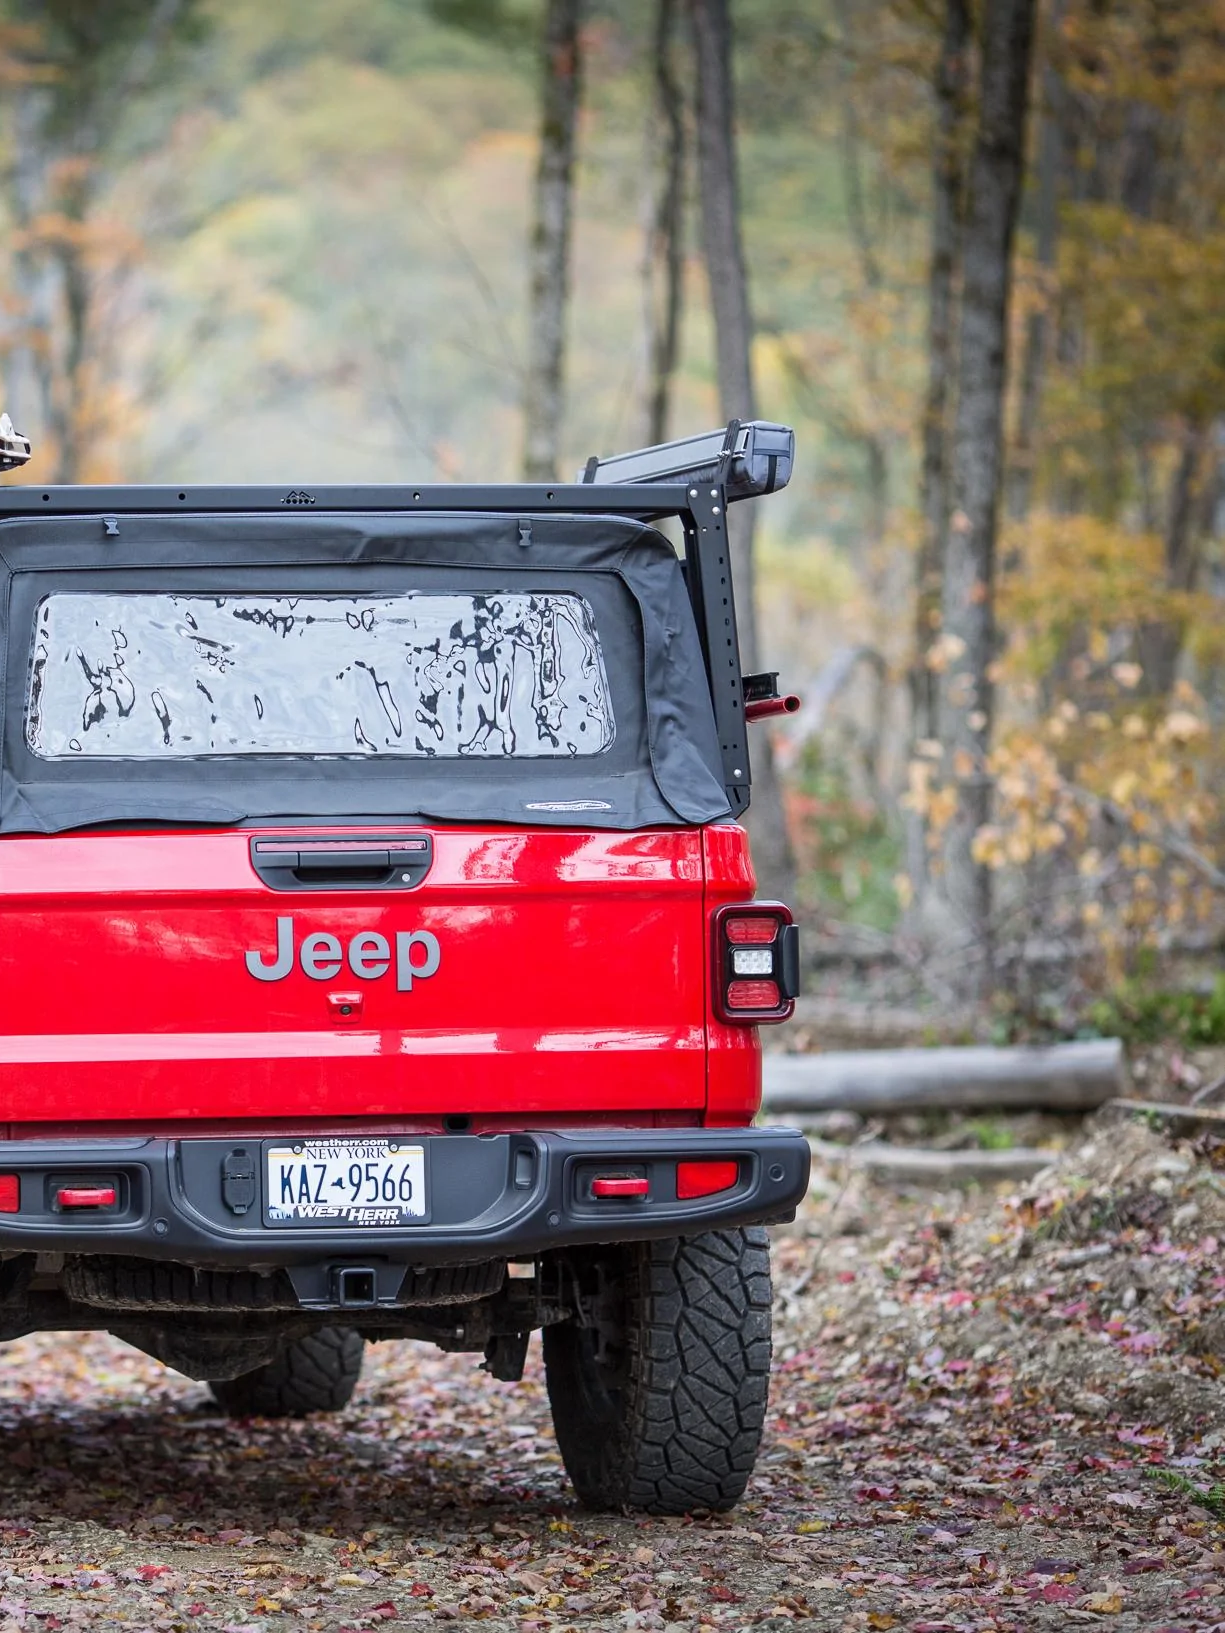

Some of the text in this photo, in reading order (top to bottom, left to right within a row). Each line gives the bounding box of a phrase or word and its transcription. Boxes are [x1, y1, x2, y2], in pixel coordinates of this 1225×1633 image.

[245, 916, 441, 992] Jeep
[304, 1139, 389, 1147] westherr.com
[306, 1147, 388, 1160] NEW YORK
[280, 1163, 413, 1205] KAZ 9566
